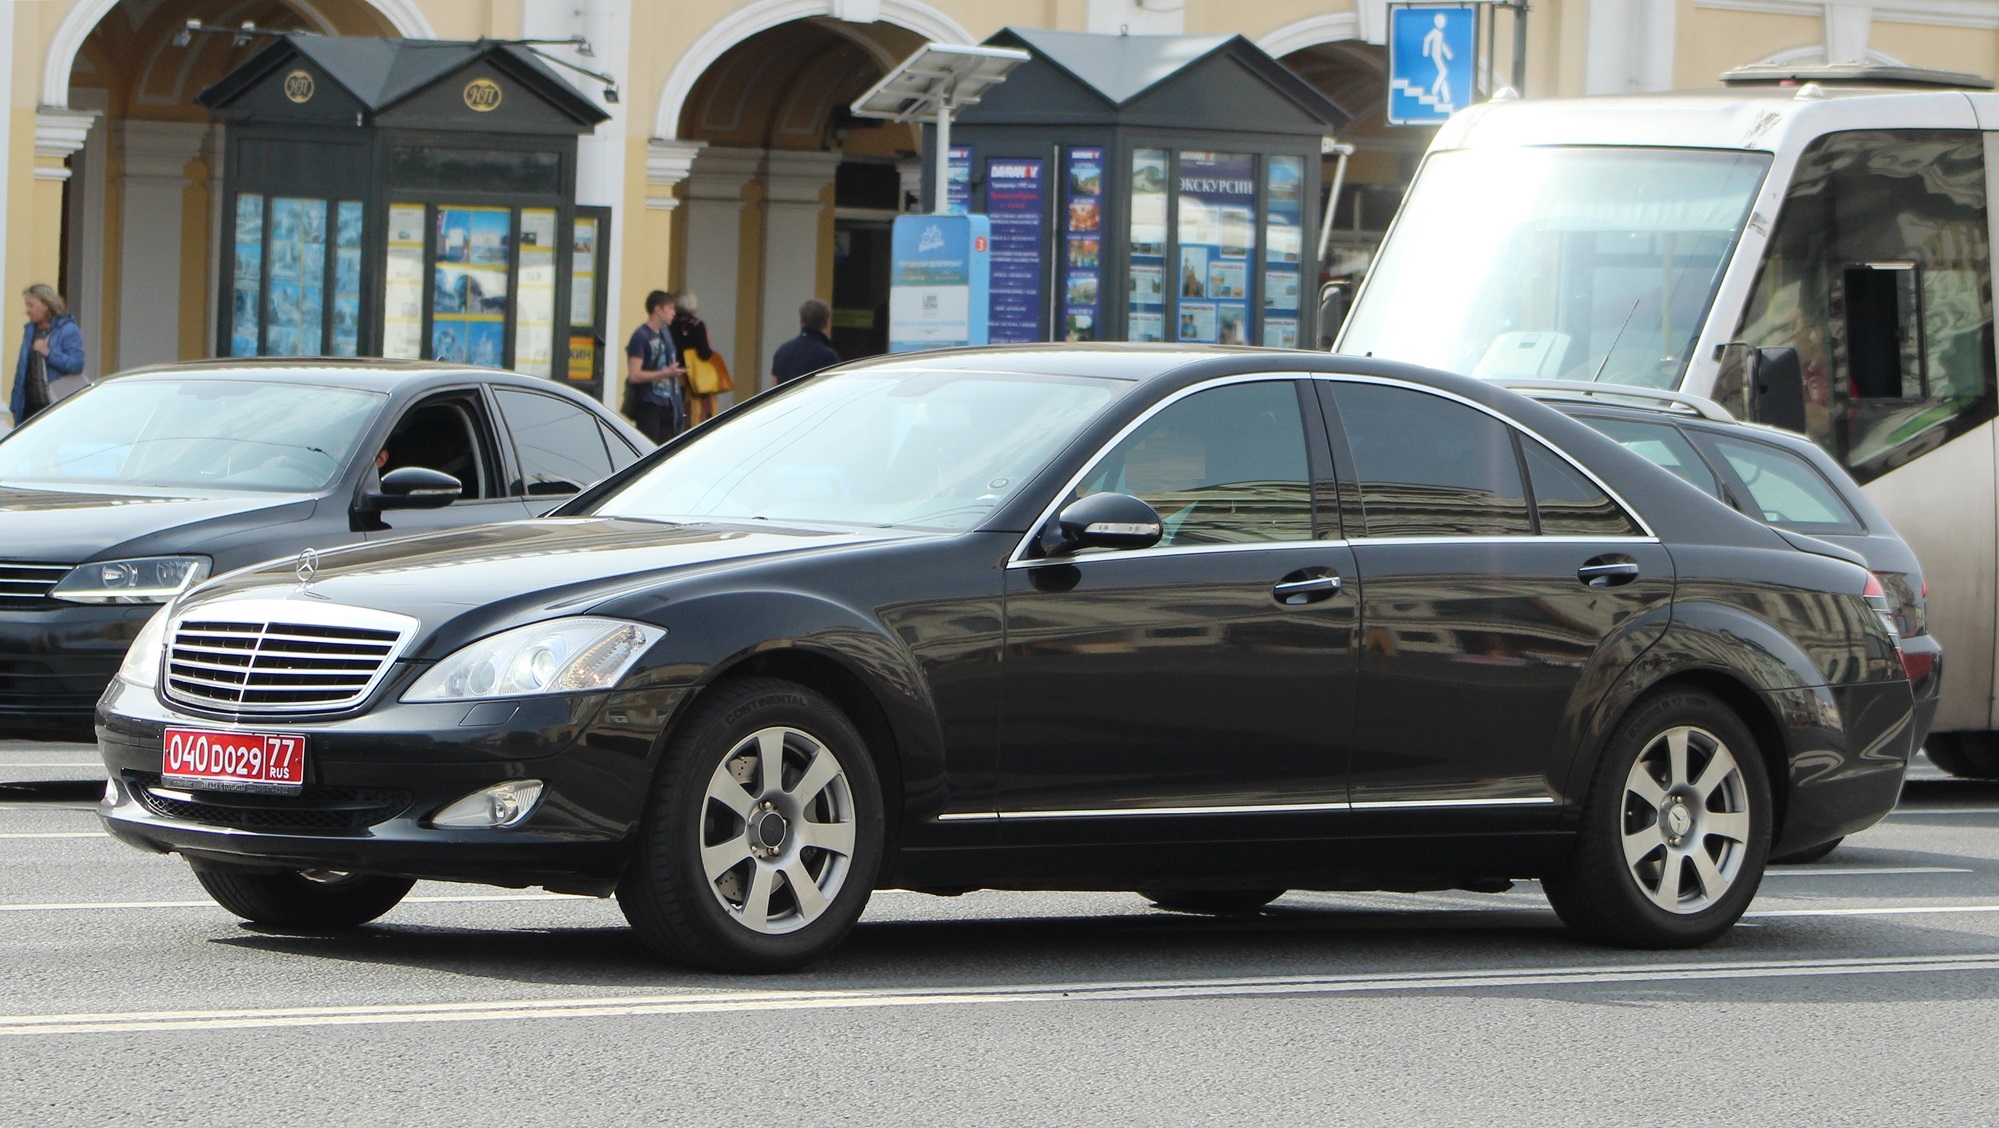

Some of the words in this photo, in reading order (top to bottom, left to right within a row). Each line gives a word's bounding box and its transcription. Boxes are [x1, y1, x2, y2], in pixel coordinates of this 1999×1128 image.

[1179, 178, 1253, 195] ЭКСКУРСИИ
[978, 239, 985, 252] 3
[725, 694, 807, 725] CONTINENTAL
[268, 738, 295, 767] 77
[269, 767, 290, 779] RUS
